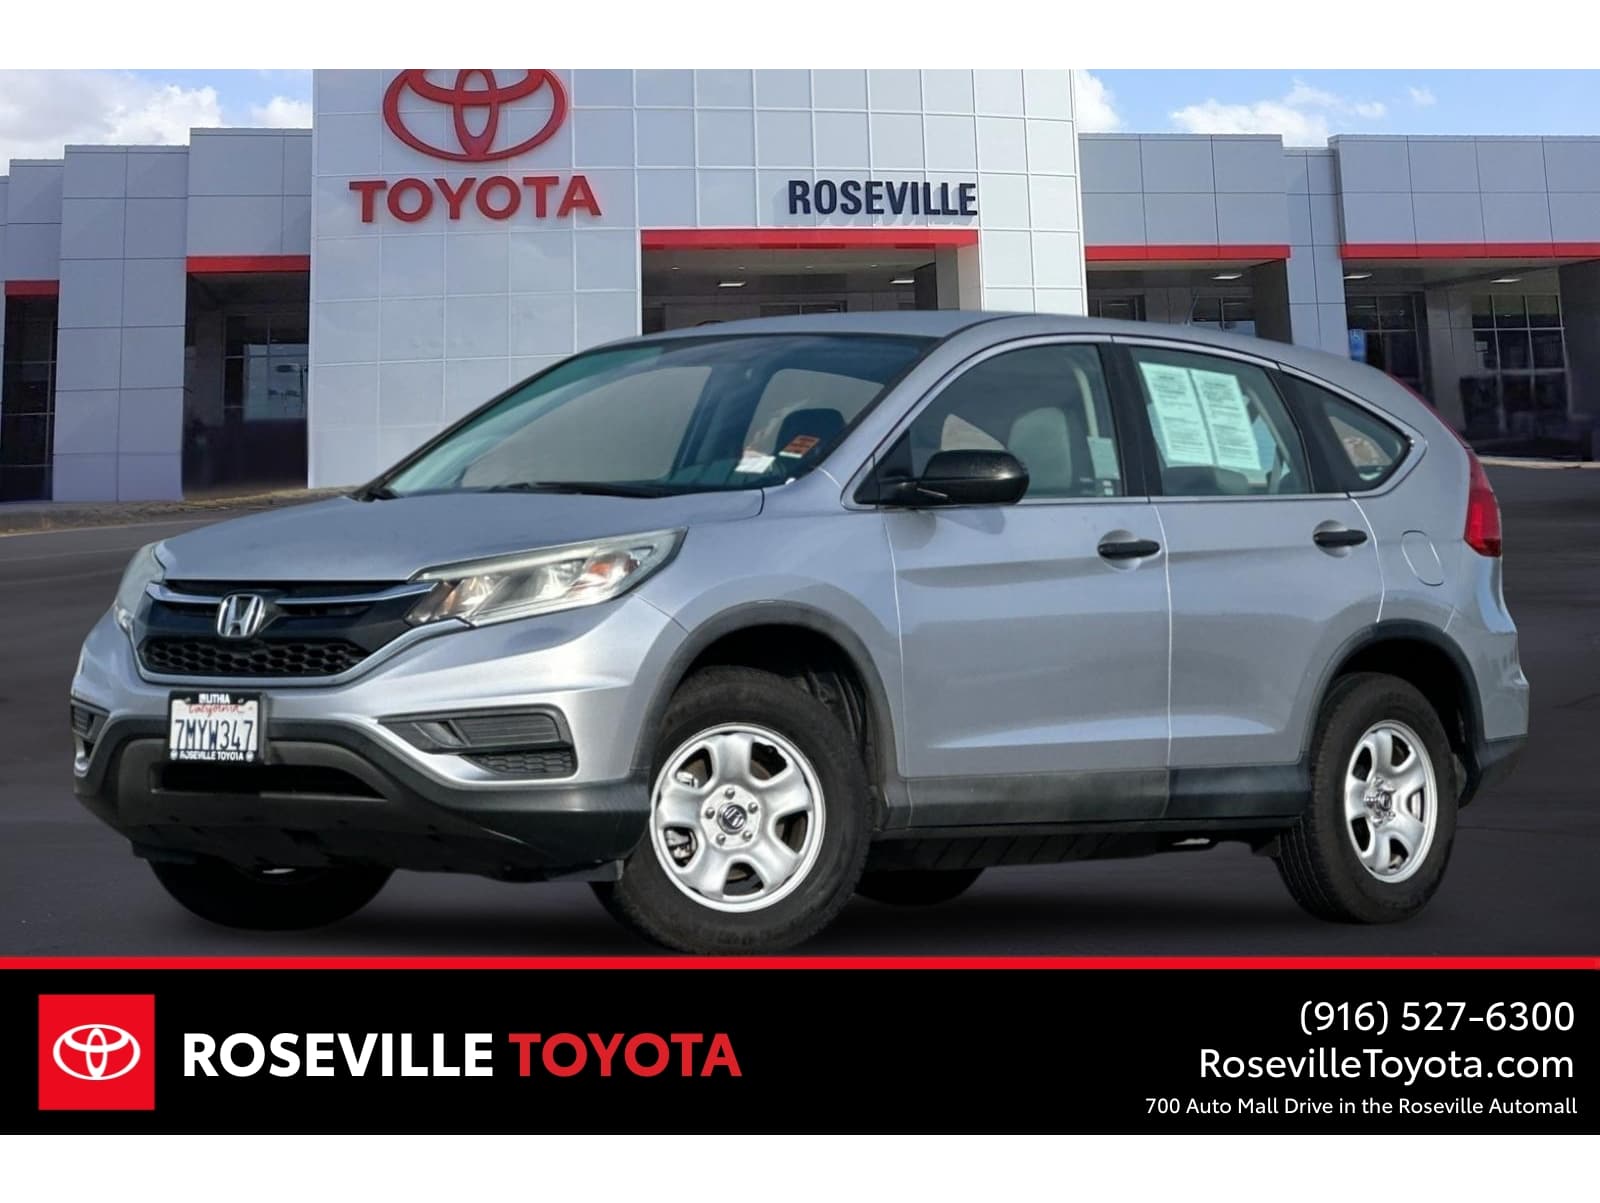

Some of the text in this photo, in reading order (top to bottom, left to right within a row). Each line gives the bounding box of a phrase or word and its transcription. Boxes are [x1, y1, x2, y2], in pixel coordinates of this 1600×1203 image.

[349, 175, 602, 222] TOYOTA
[788, 180, 979, 217] ROSEVILLE
[175, 719, 254, 751] 7MYW347
[179, 751, 245, 761] ROSEVILLE TOYOTA
